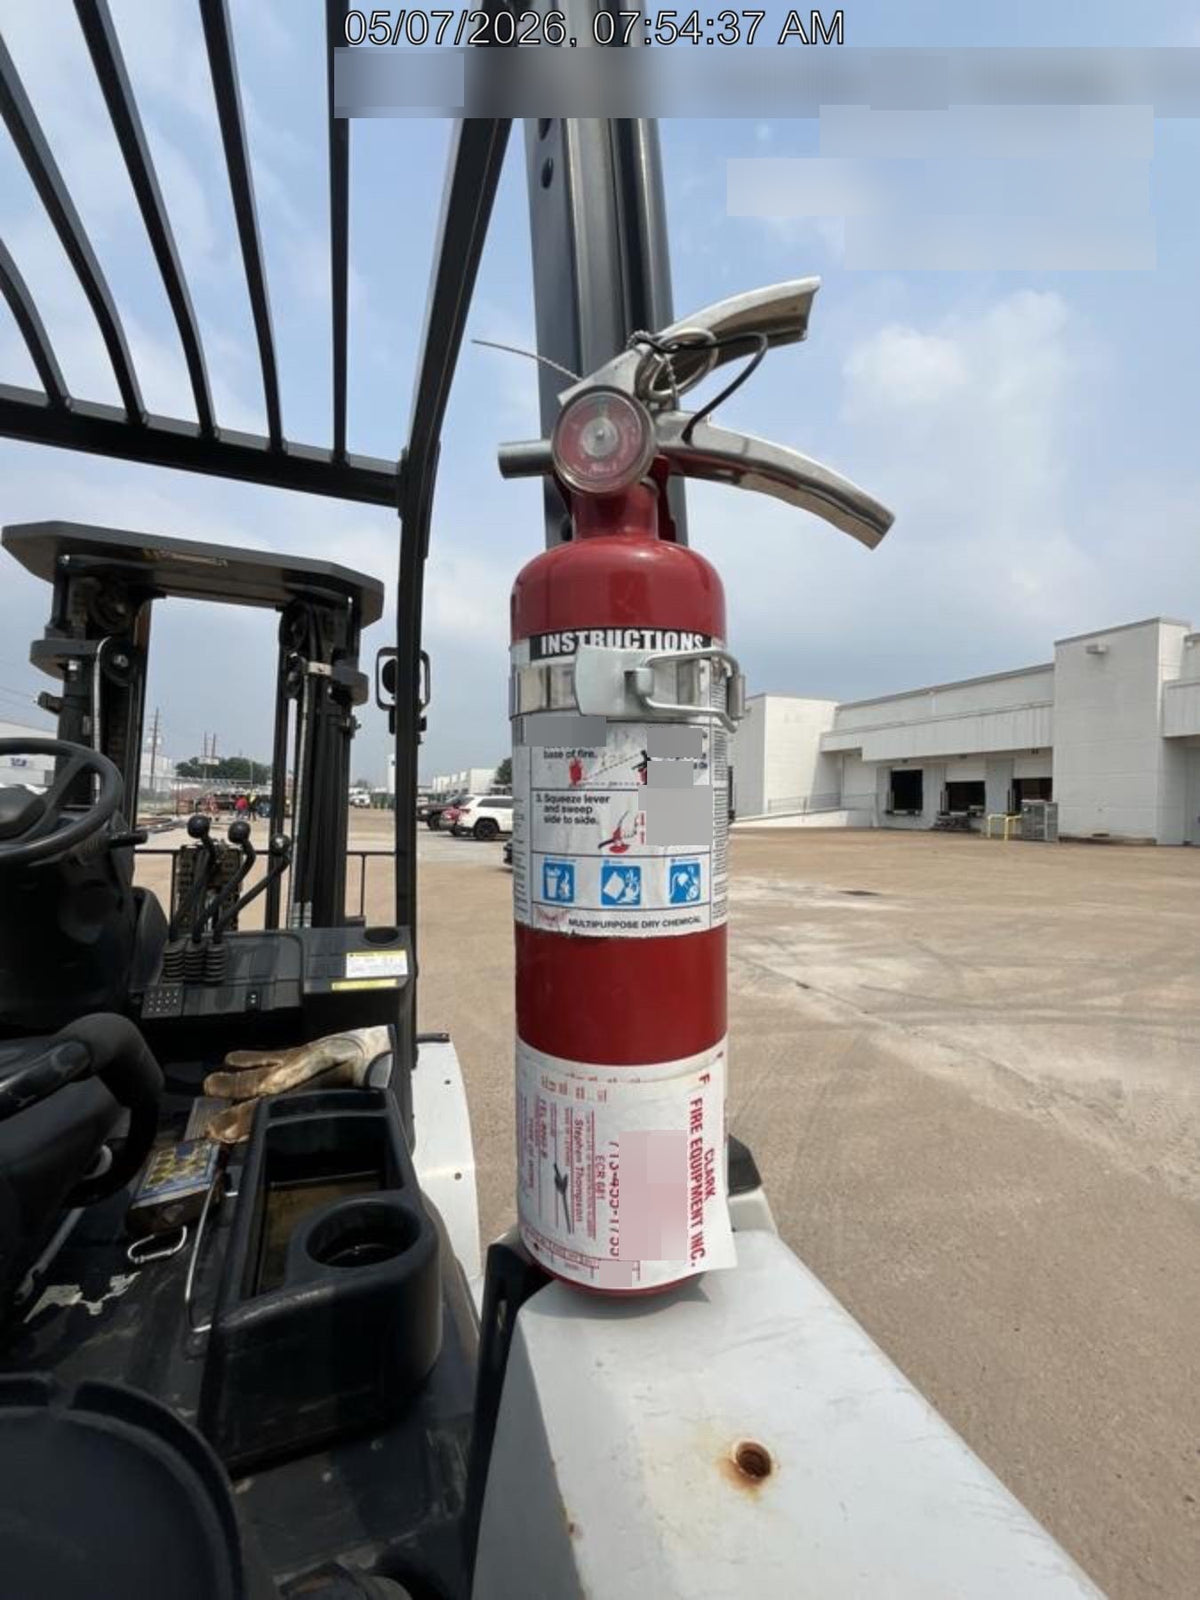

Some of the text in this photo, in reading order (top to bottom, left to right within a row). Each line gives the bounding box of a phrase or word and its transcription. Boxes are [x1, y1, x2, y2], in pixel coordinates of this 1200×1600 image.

[540, 629, 704, 655] INSTRUCTIONS
[544, 793, 582, 805] Squeeze
[584, 793, 610, 805] lever
[561, 806, 593, 815] sweep
[563, 816, 573, 825] to
[574, 815, 598, 825] side.
[568, 915, 702, 929] MULTIPURPOSE DRY CHEMICAL
[574, 1118, 585, 1162] Stephen
[690, 1097, 706, 1268] FIRE EQUIPMENT INC.
[703, 1148, 717, 1201] CLARK
